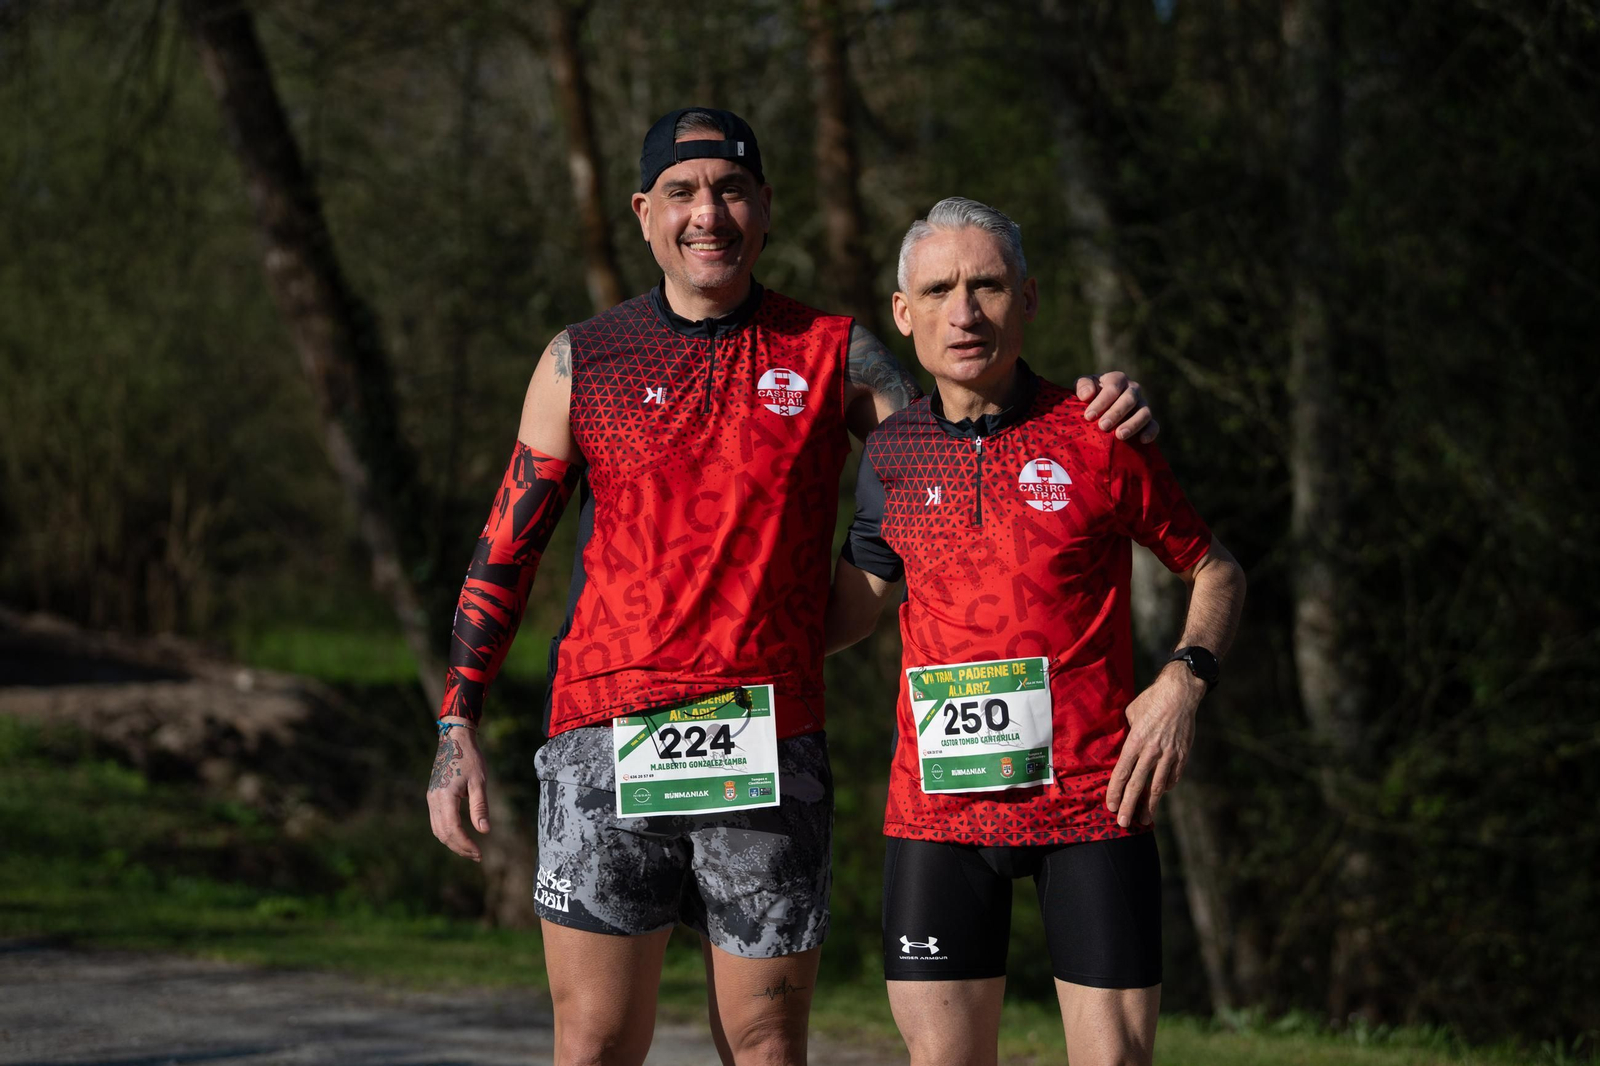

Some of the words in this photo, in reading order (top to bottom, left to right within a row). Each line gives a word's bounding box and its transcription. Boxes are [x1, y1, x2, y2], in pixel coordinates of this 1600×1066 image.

[757, 389, 802, 399] CASTRO
[771, 396, 806, 407] TRAIL
[1019, 483, 1065, 493] CASTRO
[1033, 491, 1071, 501] TRAIL
[935, 670, 956, 683] TRAIL
[958, 664, 1009, 682] PADERNE
[1012, 662, 1027, 675] DE
[948, 681, 991, 697] ALLARIZ
[669, 707, 718, 722] ALLARIZ
[943, 698, 1010, 736] 250
[659, 724, 736, 759] 224
[941, 737, 959, 747] CASTOR
[958, 736, 979, 746] TOMBO
[980, 732, 1020, 744] CANTARILLA
[650, 761, 687, 772] M.ALBERTO
[688, 759, 723, 770] GONZALEZ
[724, 757, 748, 766] CAMBA
[664, 790, 709, 800] RUNMANIAK
